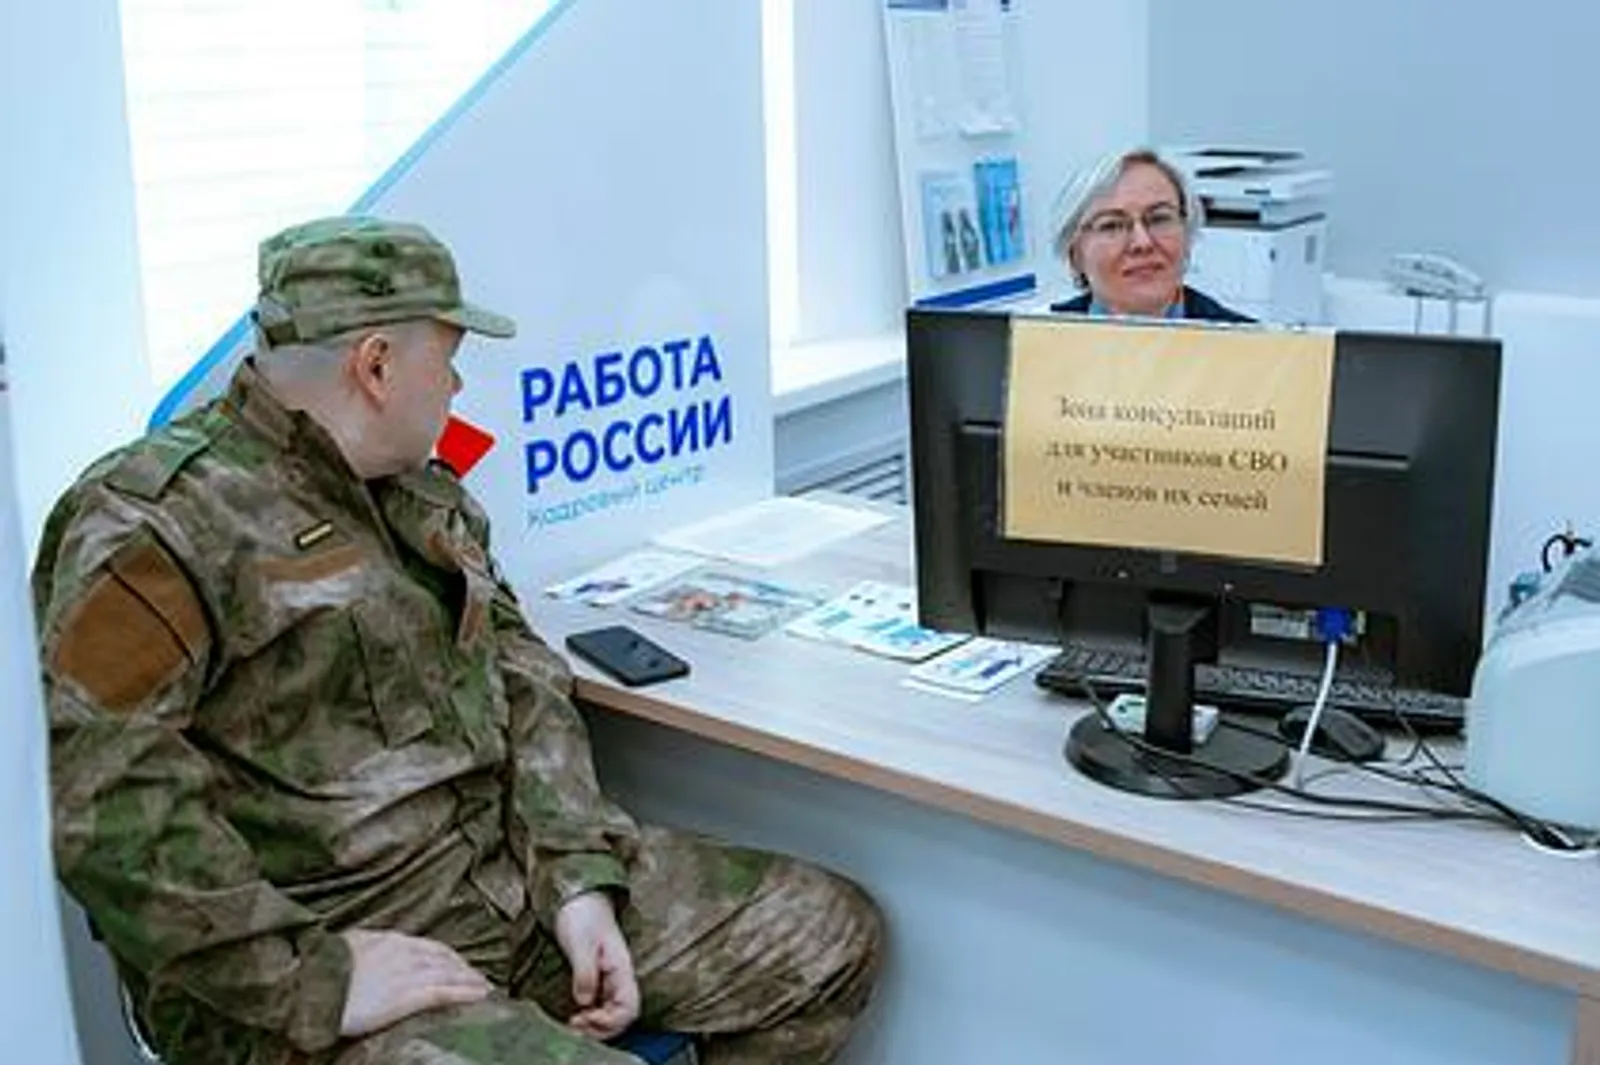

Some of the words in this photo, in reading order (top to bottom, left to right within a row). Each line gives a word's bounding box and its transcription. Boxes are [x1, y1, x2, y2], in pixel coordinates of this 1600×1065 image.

[521, 334, 722, 422] РАБОТА
[525, 394, 732, 494] РОССИИ
[1090, 443, 1222, 466] участников
[1228, 449, 1288, 473] СВО
[1057, 478, 1072, 496] и
[1163, 489, 1193, 505] их
[1198, 488, 1268, 511] семей
